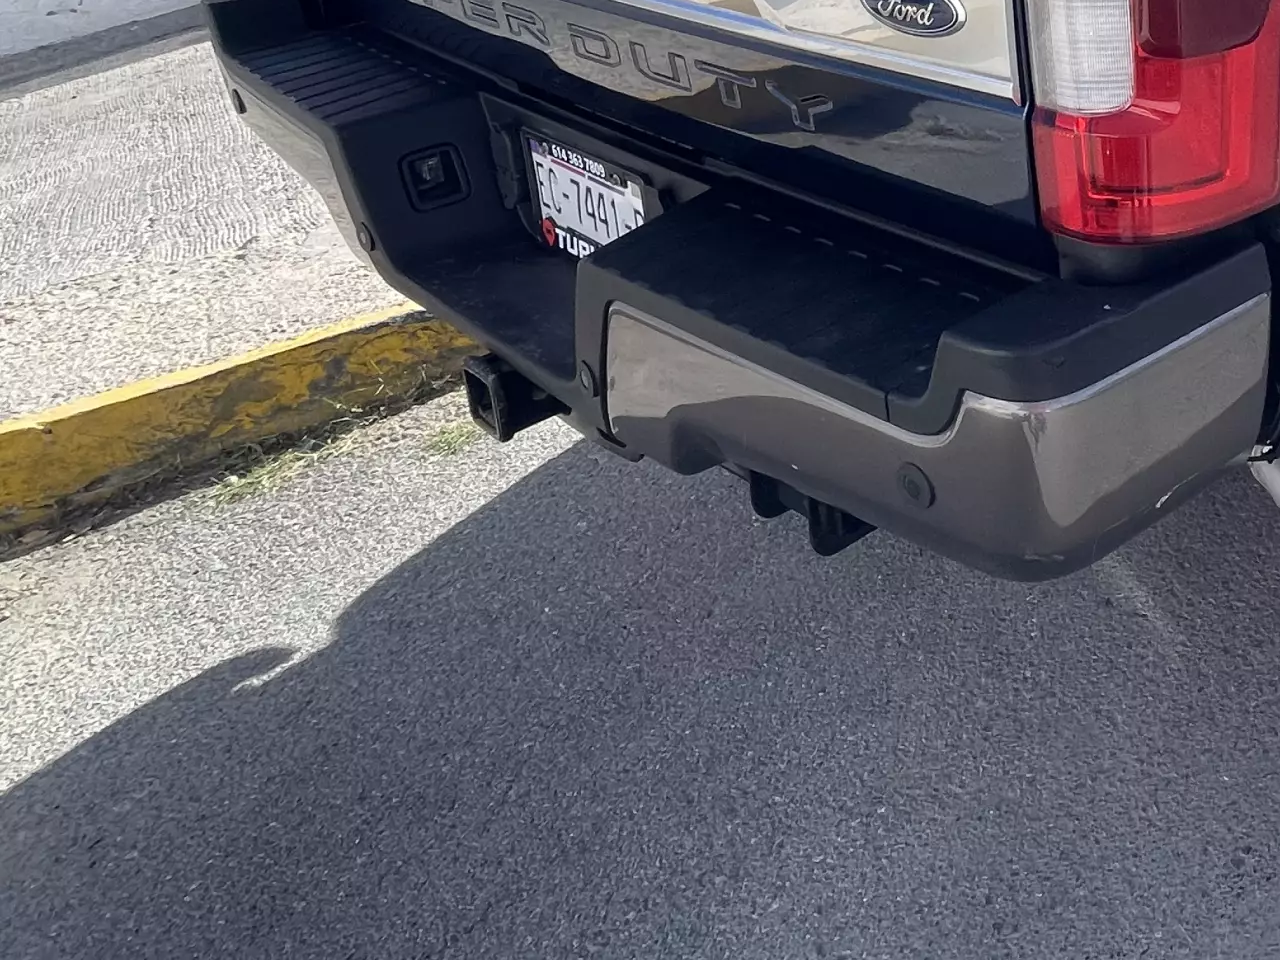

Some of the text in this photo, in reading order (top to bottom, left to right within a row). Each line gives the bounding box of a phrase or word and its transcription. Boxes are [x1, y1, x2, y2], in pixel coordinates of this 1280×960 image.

[567, 21, 834, 133] DUTY
[551, 144, 606, 178] 614 363 7809
